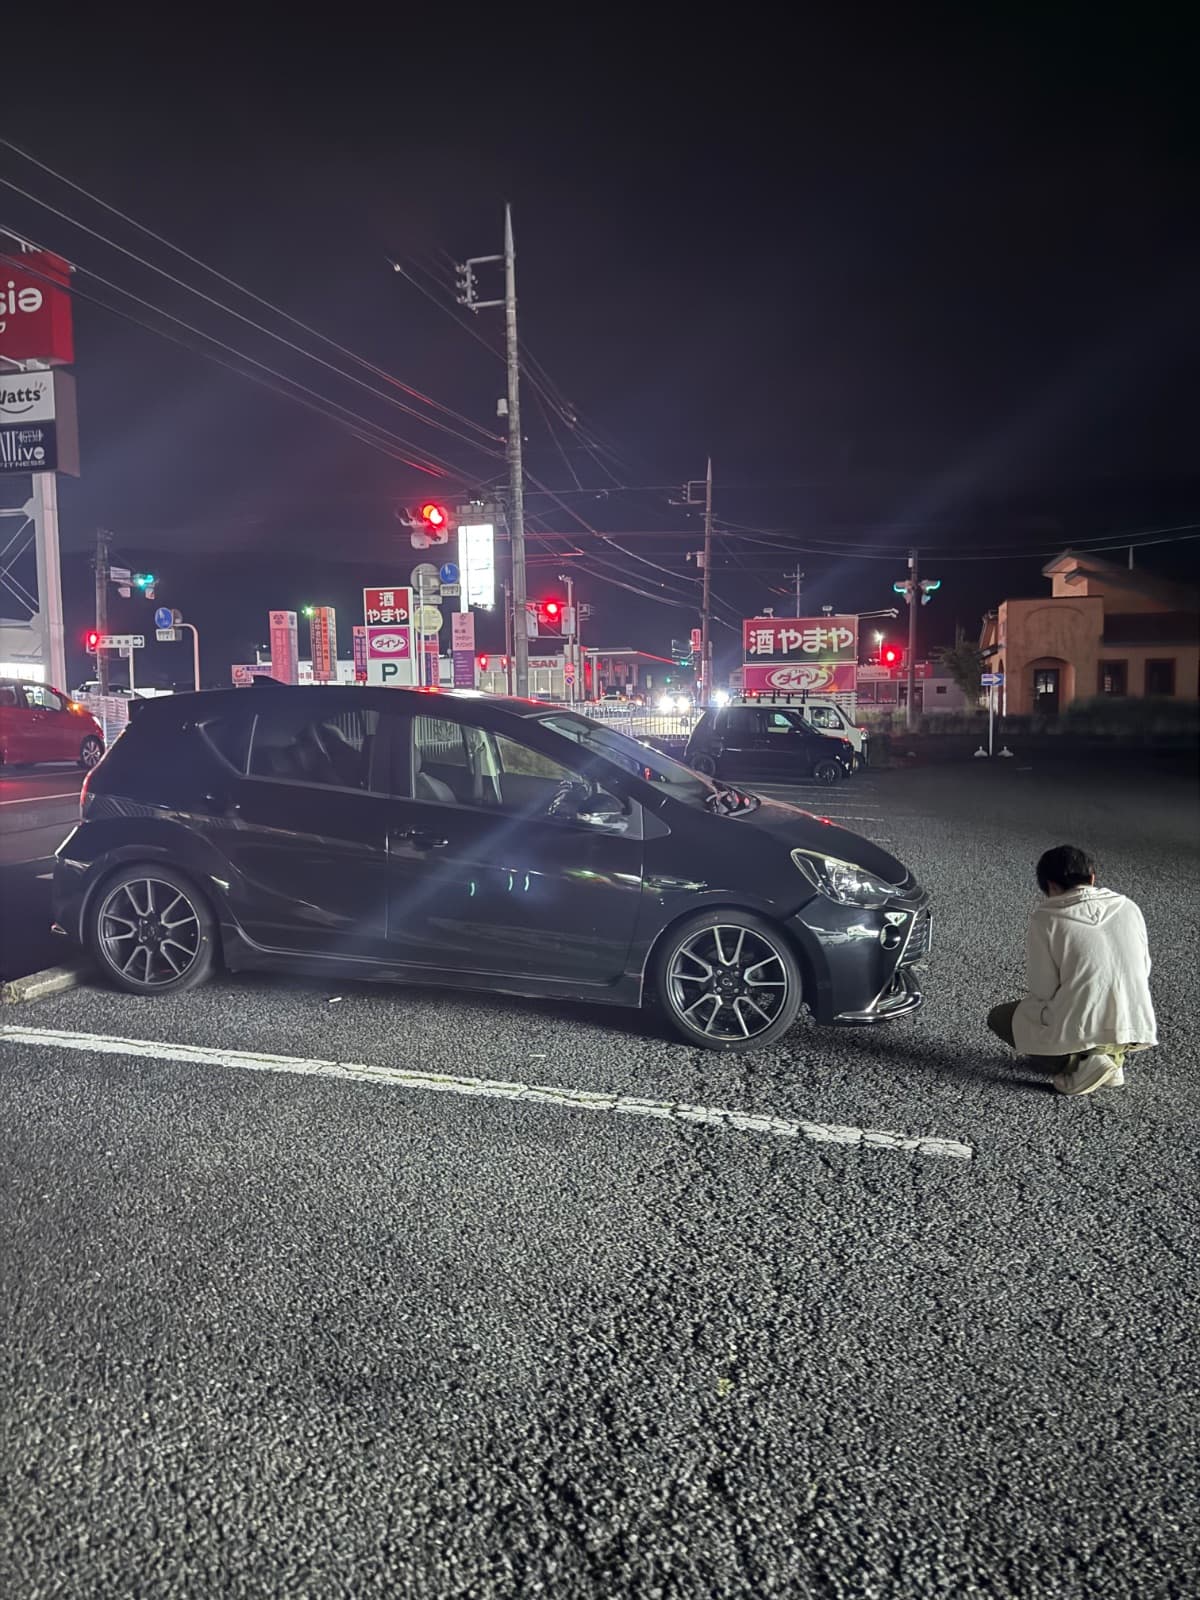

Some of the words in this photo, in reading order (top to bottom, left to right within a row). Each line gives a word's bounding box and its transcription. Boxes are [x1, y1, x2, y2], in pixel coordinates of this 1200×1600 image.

[379, 592, 394, 607] 酒
[368, 608, 408, 624] やまや
[375, 639, 405, 649] ダイソー
[382, 663, 398, 682] P
[777, 672, 826, 685] ダイソー
